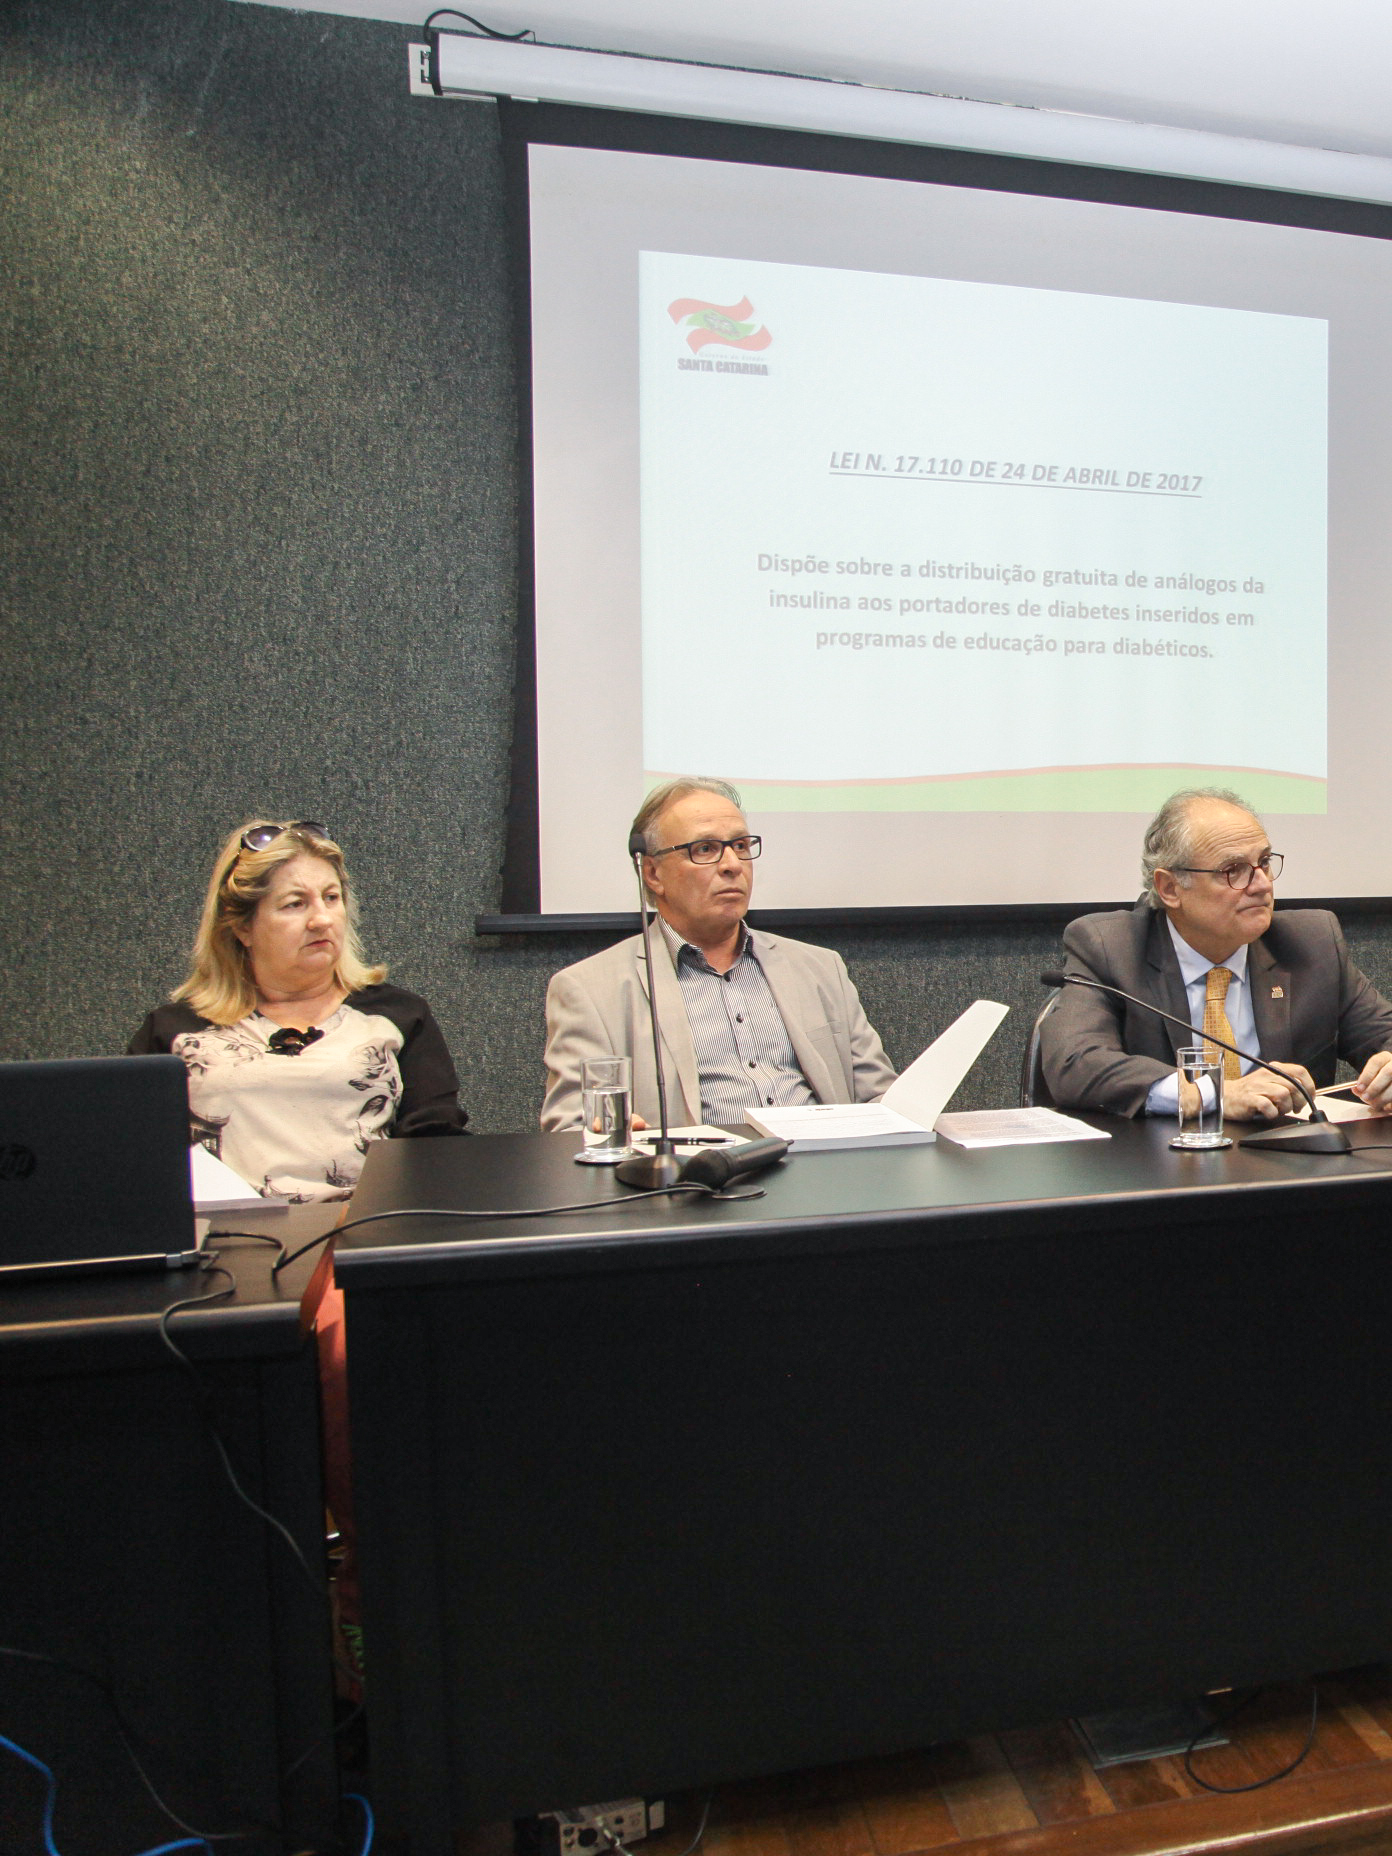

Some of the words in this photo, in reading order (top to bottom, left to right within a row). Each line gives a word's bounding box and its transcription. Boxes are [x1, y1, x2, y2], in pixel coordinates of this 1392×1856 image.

[677, 358, 714, 372] SANTA
[715, 360, 769, 376] CATARINA
[829, 451, 860, 470] LEI
[865, 453, 887, 471] N.
[894, 455, 963, 476] 17.110
[969, 460, 998, 478] DE
[1001, 462, 1026, 480] 24
[1031, 464, 1059, 483] DE
[1063, 467, 1120, 487] ABRIL
[1126, 471, 1153, 489] DE
[1156, 473, 1203, 492] 2017
[757, 553, 830, 576] Dispõe
[836, 557, 893, 577] sobre
[900, 563, 912, 578] a
[918, 560, 1036, 586] distribuição
[1042, 568, 1118, 588] gratuita
[1124, 570, 1148, 588] de
[1154, 572, 1237, 595] análogos
[1242, 576, 1265, 594] da
[769, 589, 850, 610] insulina
[857, 596, 892, 612] aos
[899, 596, 1010, 616] portadores
[1017, 599, 1041, 617] de
[1047, 600, 1130, 621] diabetes
[1135, 604, 1220, 625] inseridos
[1225, 612, 1255, 626] em
[816, 631, 926, 650] programas
[932, 631, 957, 649] de
[963, 632, 1057, 655] educação
[1064, 638, 1106, 656] para
[1112, 637, 1214, 659] diabéticos.
